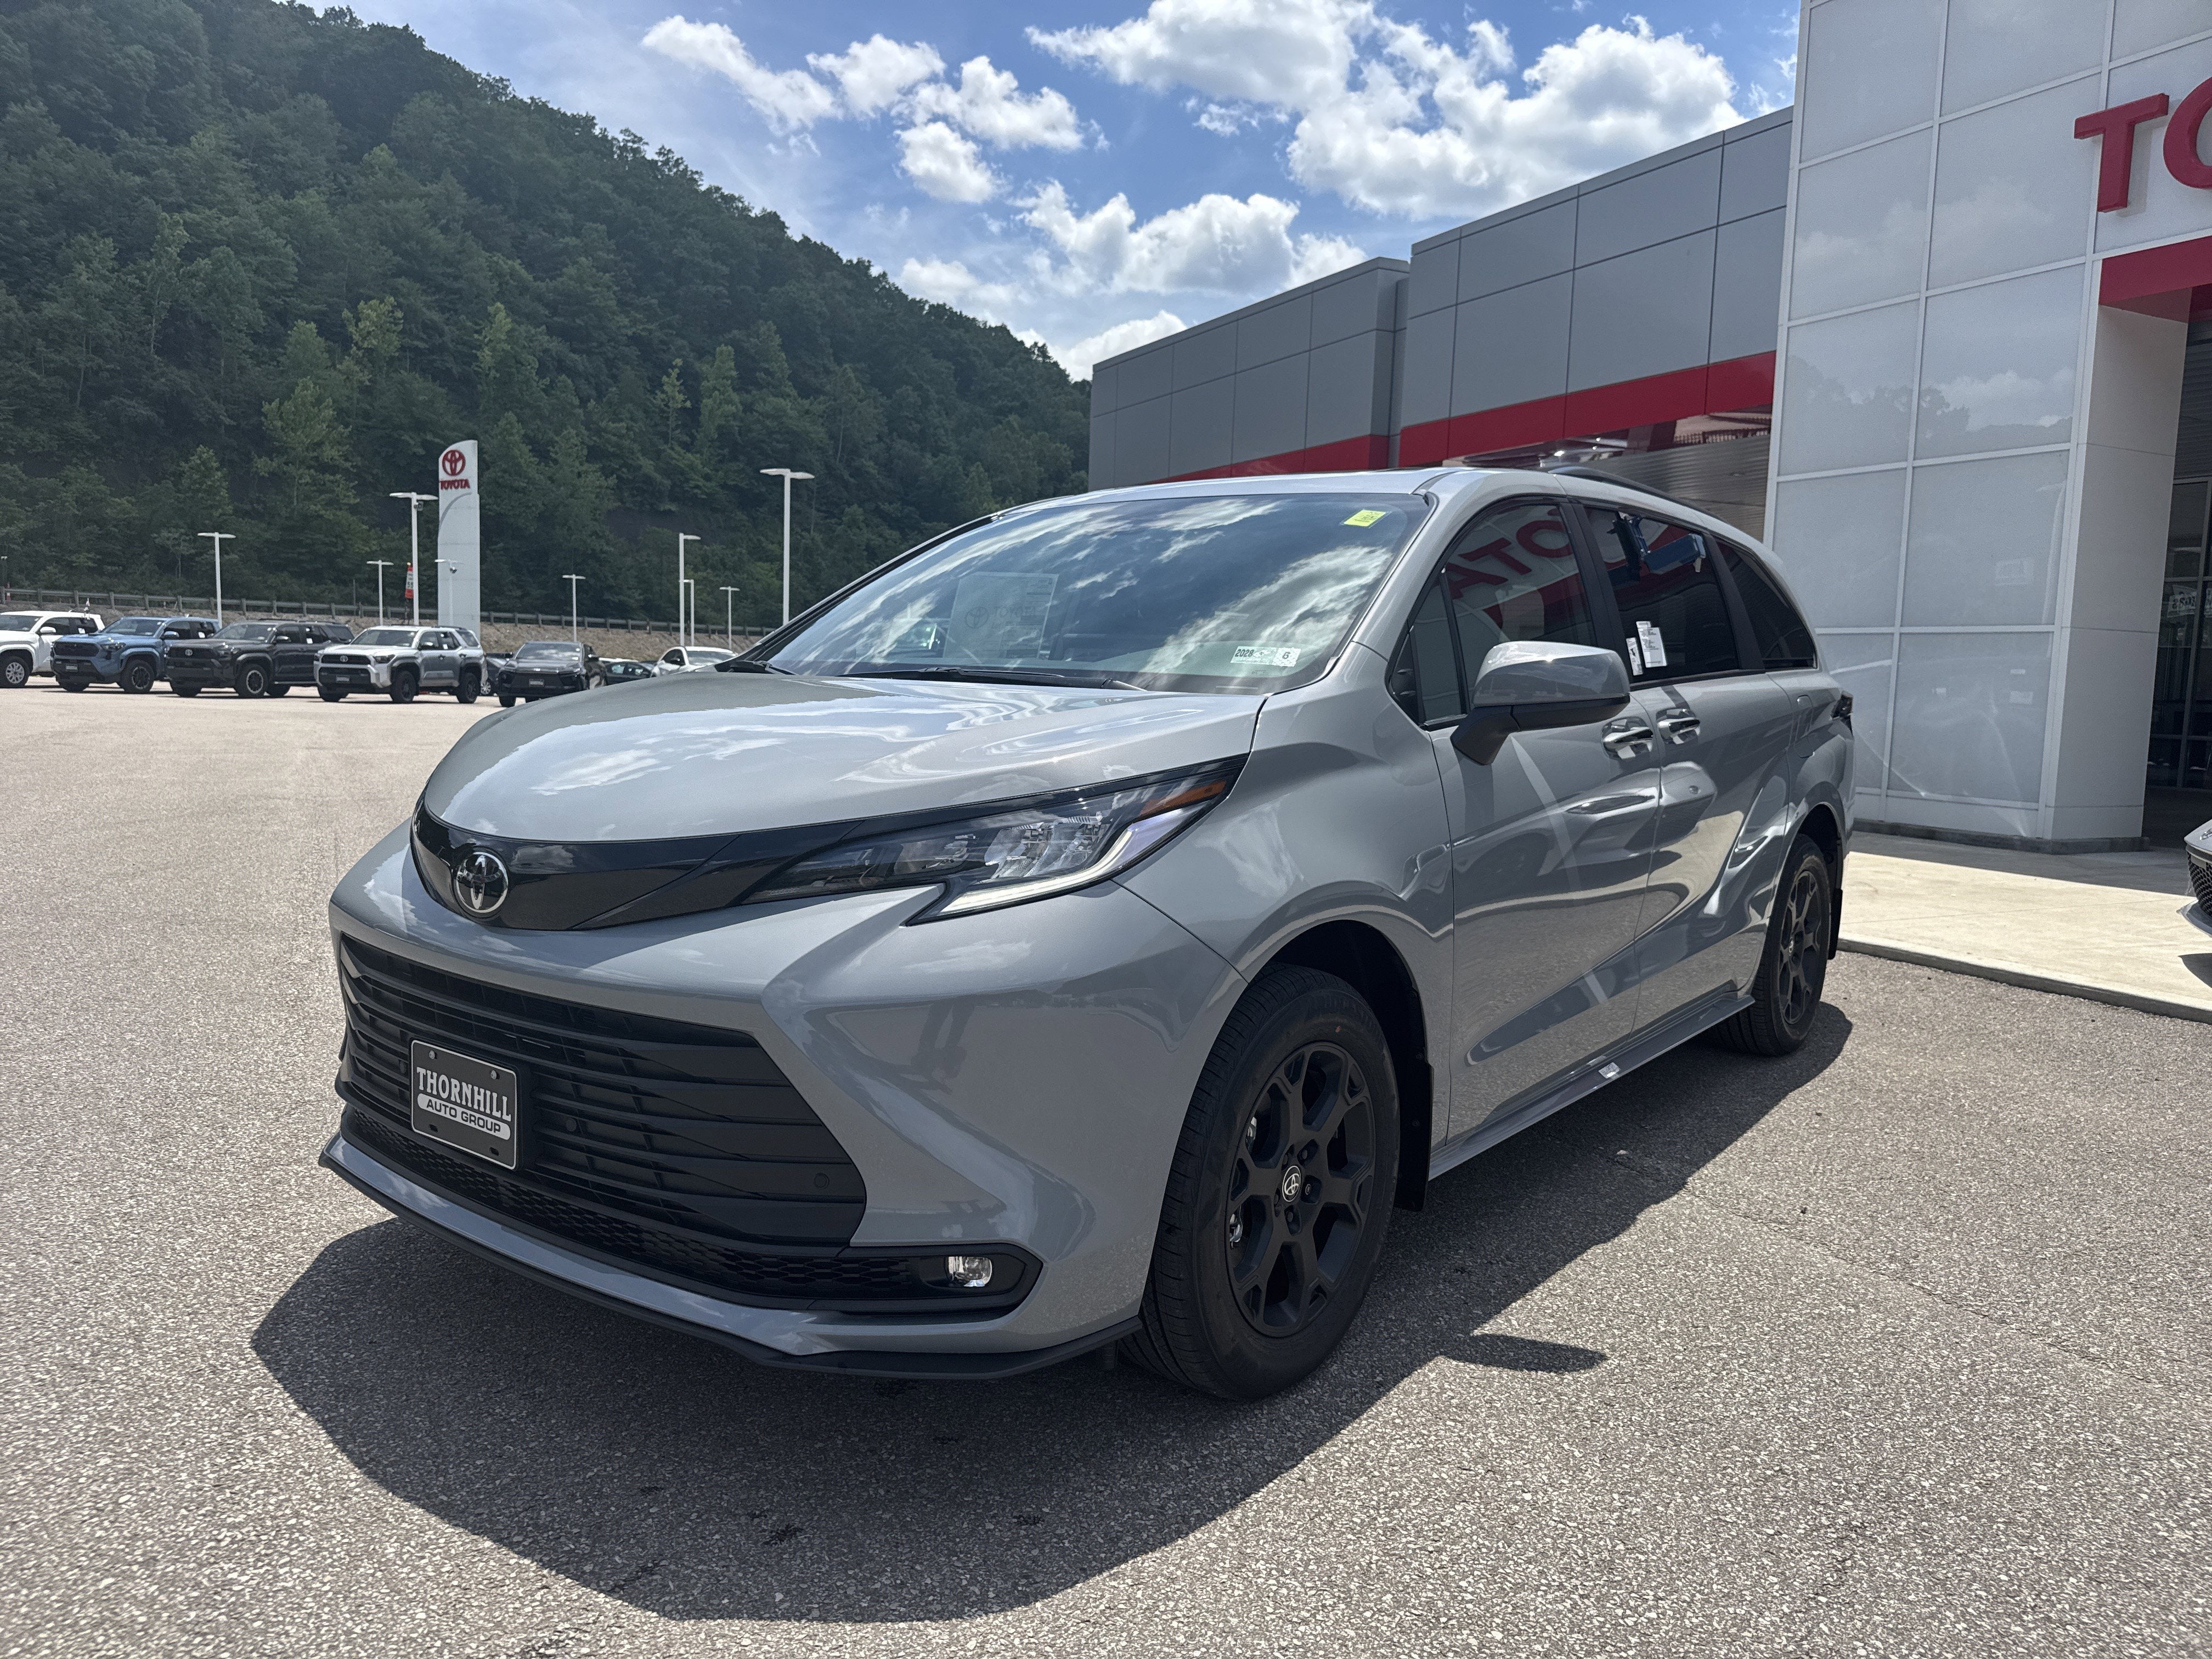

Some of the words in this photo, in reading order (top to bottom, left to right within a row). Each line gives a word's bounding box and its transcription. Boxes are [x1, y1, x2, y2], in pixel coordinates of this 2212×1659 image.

[439, 478, 470, 490] TOYOTA
[1235, 648, 1255, 658] 2028
[1282, 651, 1291, 660] 6
[416, 1066, 511, 1122] THORNHILL
[426, 1099, 458, 1118] AUTO
[461, 1110, 501, 1133] GROUP
